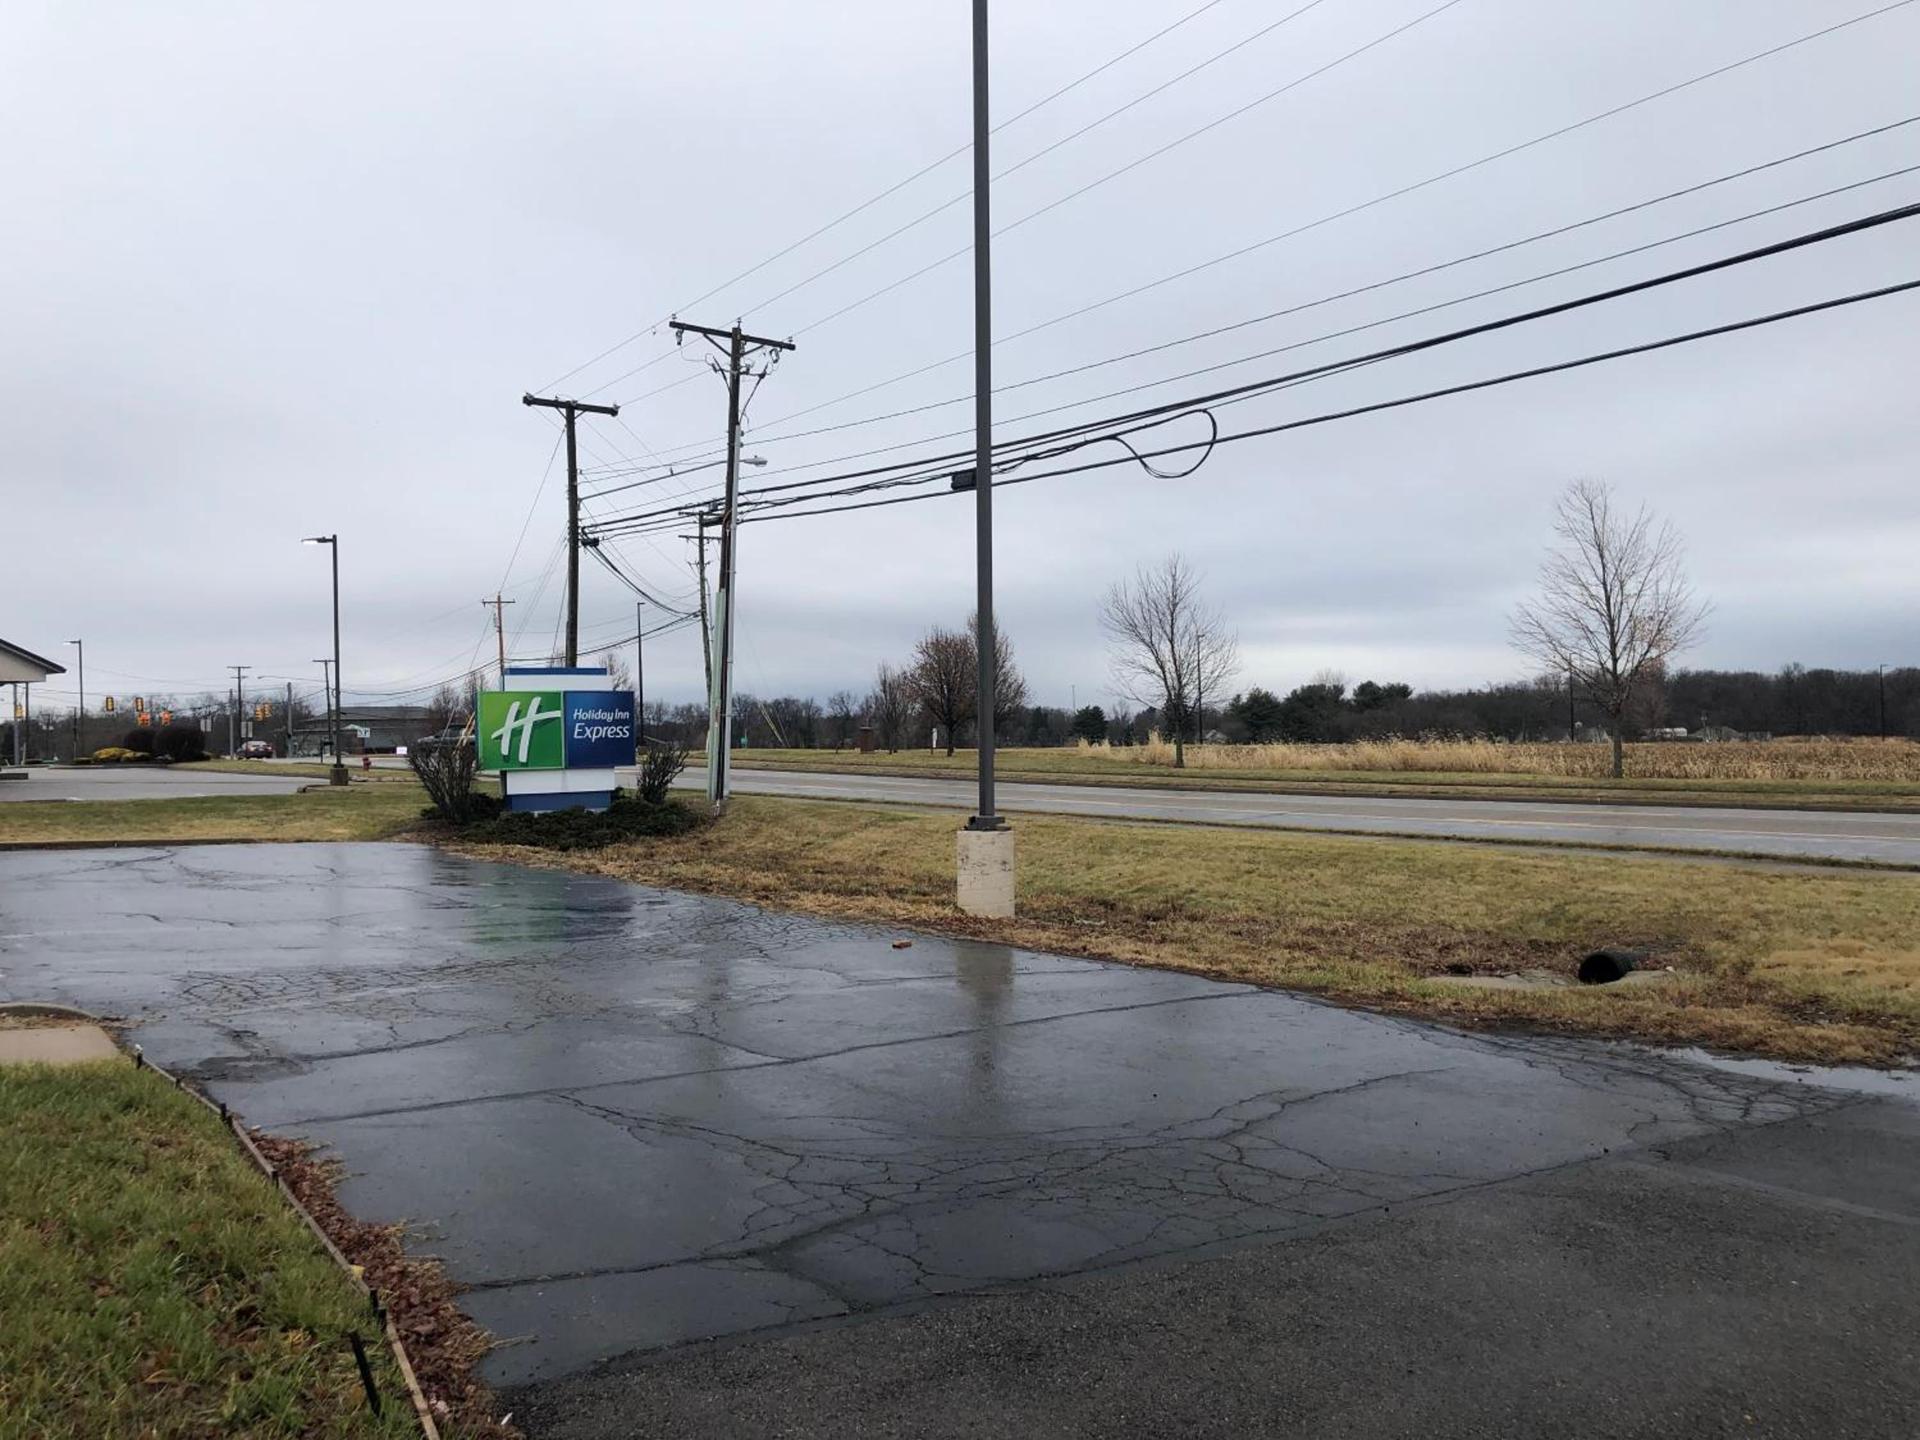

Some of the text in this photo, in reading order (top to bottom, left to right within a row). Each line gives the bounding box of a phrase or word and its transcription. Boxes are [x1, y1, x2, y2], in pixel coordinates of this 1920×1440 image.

[573, 708, 630, 722] Holiday Inn
[491, 696, 561, 763] H
[573, 722, 630, 743] Express
